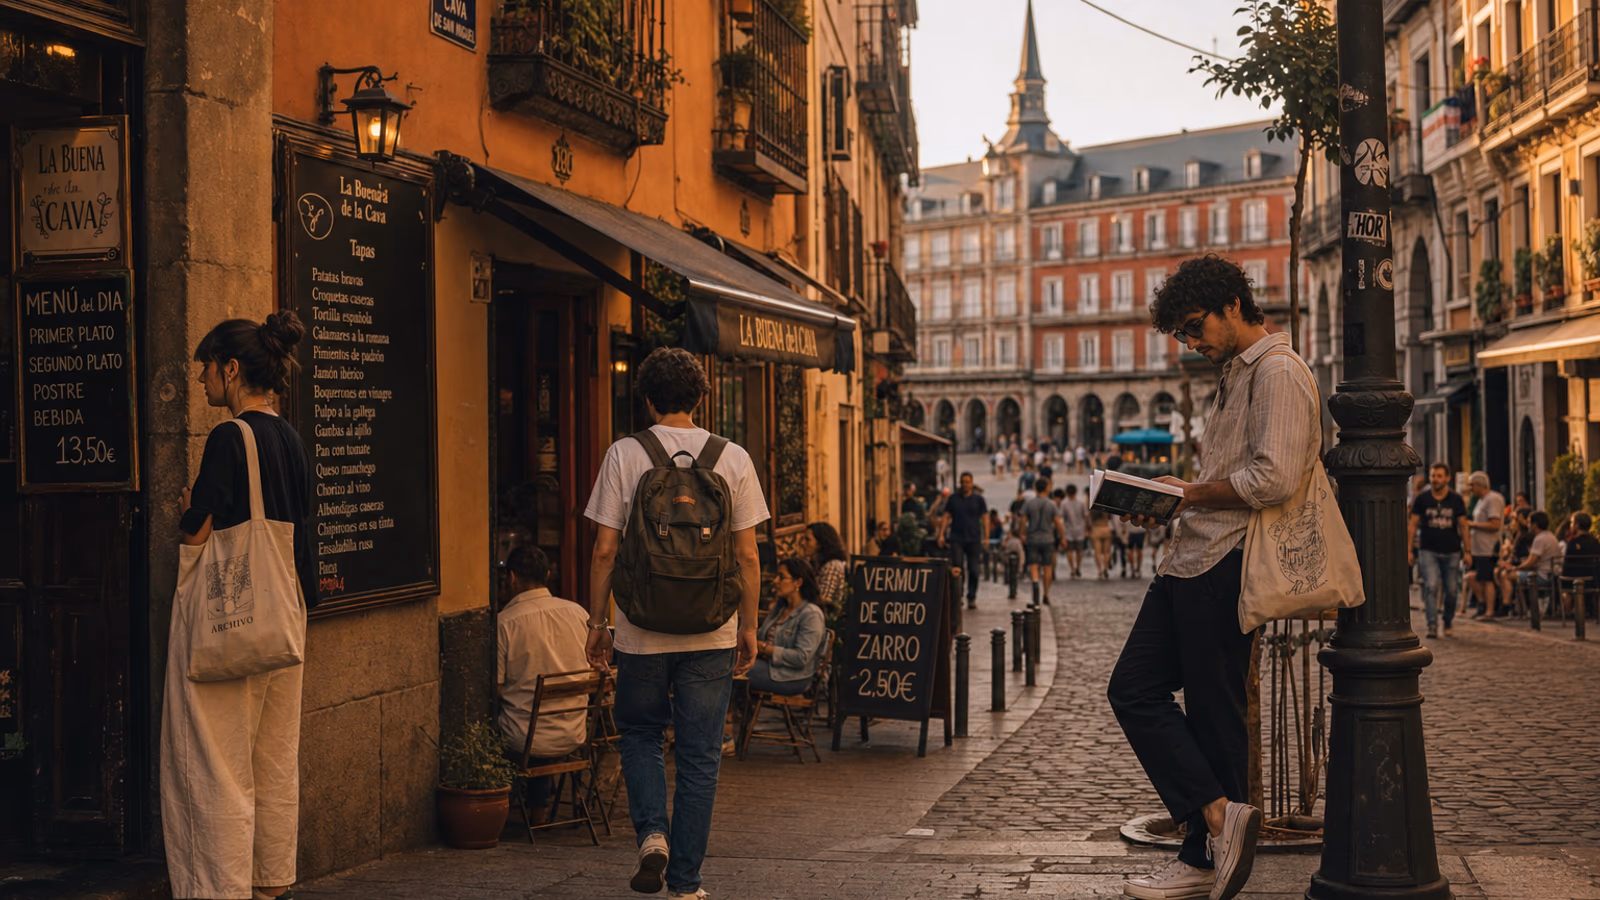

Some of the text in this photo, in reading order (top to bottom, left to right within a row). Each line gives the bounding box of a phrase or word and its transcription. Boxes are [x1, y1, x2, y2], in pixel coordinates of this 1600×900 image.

[434, 12, 442, 29] DE
[443, 16, 455, 34] SAN
[340, 175, 352, 196] La
[45, 200, 98, 231] CAVA
[341, 199, 386, 224] de la Cava
[349, 239, 376, 262] Tapas
[312, 267, 340, 284] Patatas
[26, 286, 124, 316] MENÚ del DIA
[312, 287, 349, 305] Croquetas
[312, 306, 341, 321] Tortilla
[29, 325, 115, 345] PRIMER PLATO
[312, 326, 350, 341] Calamares
[352, 332, 356, 342] a
[357, 329, 364, 342] la
[739, 314, 755, 347] LA
[755, 317, 785, 352] BUENA
[313, 345, 350, 360] Pimientos
[351, 348, 360, 361] de
[29, 353, 123, 373] SEGUNDO PLATO
[313, 364, 364, 380] Jamón ibérico
[33, 382, 85, 401] POSTRE
[314, 385, 357, 402] Boquerones
[358, 390, 367, 399] en
[33, 408, 85, 427] BEBIDA
[314, 404, 376, 421] Pulpo a la gallega
[315, 423, 344, 437] Gambas
[346, 422, 354, 436] al
[55, 435, 117, 466] 13,50€
[315, 443, 371, 457] Pan con tomate
[315, 460, 376, 479] Queso manchego
[316, 480, 371, 497] Chorizo al vino
[359, 501, 385, 512] caseras
[317, 516, 395, 539] Chipirones en su tinta
[358, 540, 374, 550] rusa
[863, 566, 933, 593] VERMUT
[860, 601, 927, 625] DE GRIFO
[211, 616, 254, 634] ARCHIVO
[856, 634, 920, 662] ZARRO
